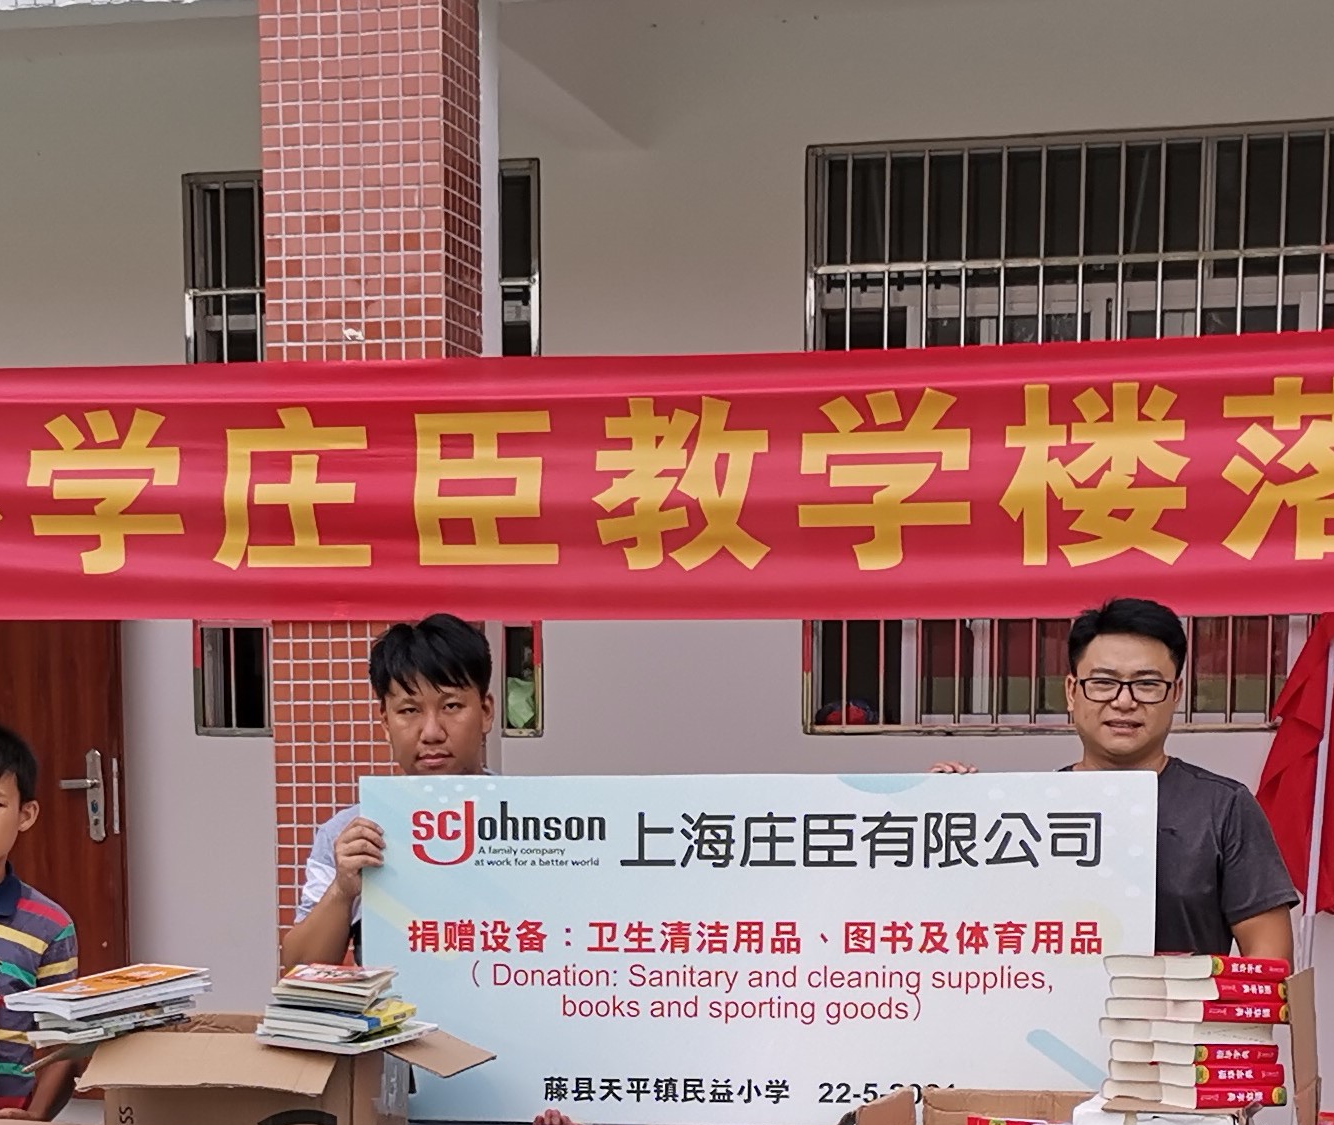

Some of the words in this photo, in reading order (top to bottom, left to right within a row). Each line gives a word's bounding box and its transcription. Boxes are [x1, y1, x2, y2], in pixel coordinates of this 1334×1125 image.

[478, 846, 486, 854] A
[488, 845, 518, 856] family
[520, 846, 566, 856] company
[619, 809, 1103, 870] 上海庄臣有限公司
[474, 858, 484, 866] at
[487, 857, 512, 866] work
[514, 857, 528, 866] for
[538, 857, 569, 866] better
[571, 857, 600, 866] world
[492, 963, 618, 987] Donation:
[628, 963, 739, 993] Sanitary
[748, 965, 797, 988] and
[807, 965, 921, 995] cleaning
[931, 966, 1054, 995] supplies,
[561, 994, 641, 1018] books
[650, 995, 700, 1018] and
[708, 996, 816, 1025] sporting
[825, 994, 923, 1025] goods)
[543, 1075, 791, 1105] 藤县天平镇民益小学
